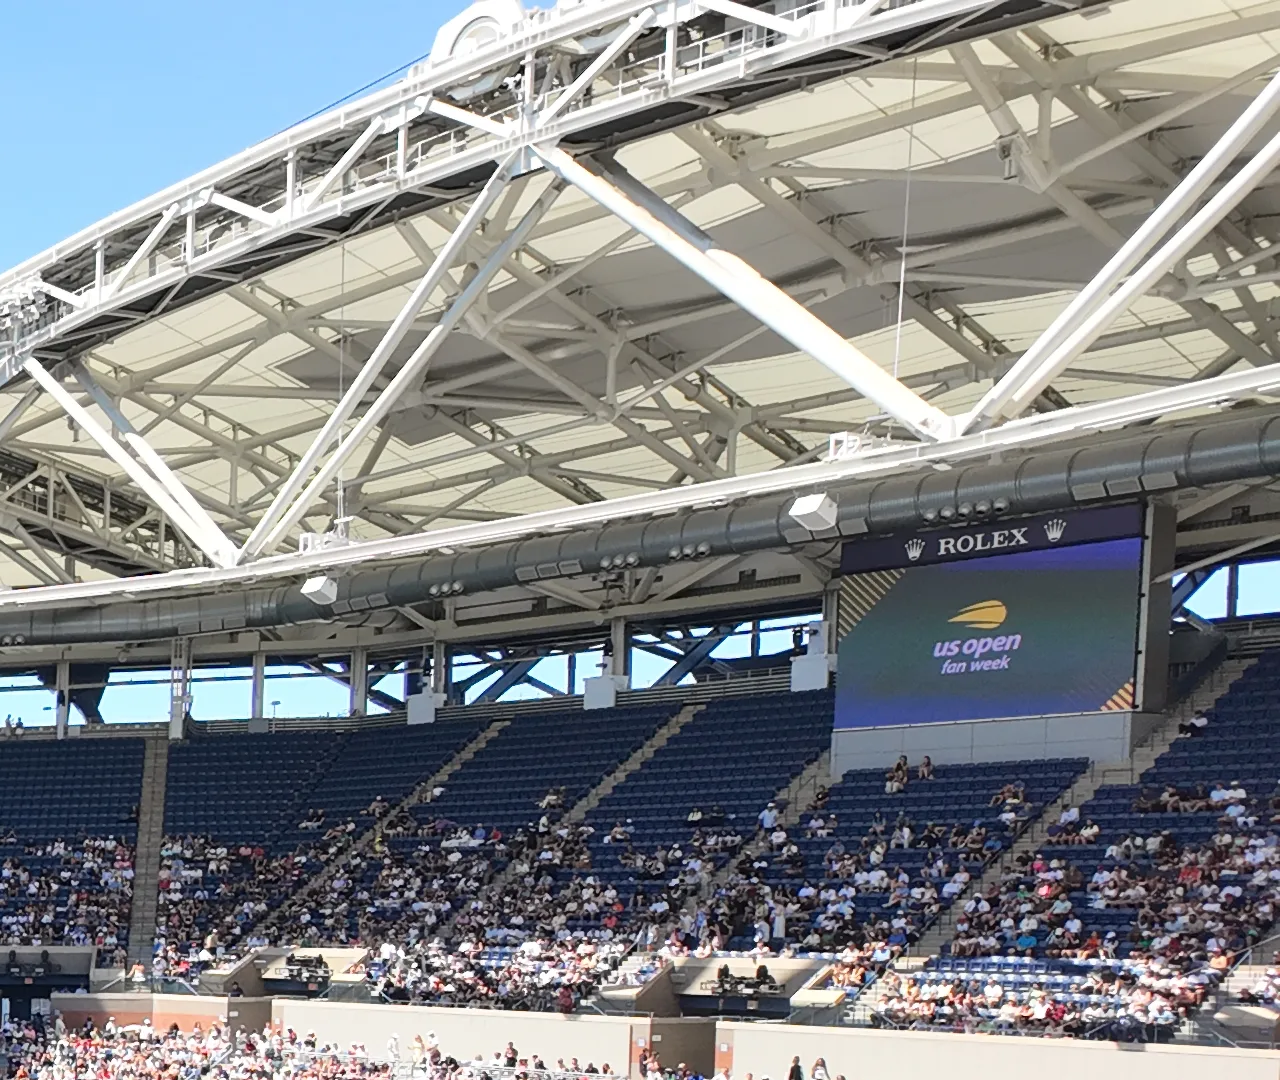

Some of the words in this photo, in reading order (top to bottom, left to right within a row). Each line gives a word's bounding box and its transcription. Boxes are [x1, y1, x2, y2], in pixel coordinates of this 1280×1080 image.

[937, 527, 1029, 556] ROLEX
[933, 640, 960, 658] us
[961, 633, 1022, 656] open
[940, 658, 967, 675] fan
[969, 655, 1012, 673] week
